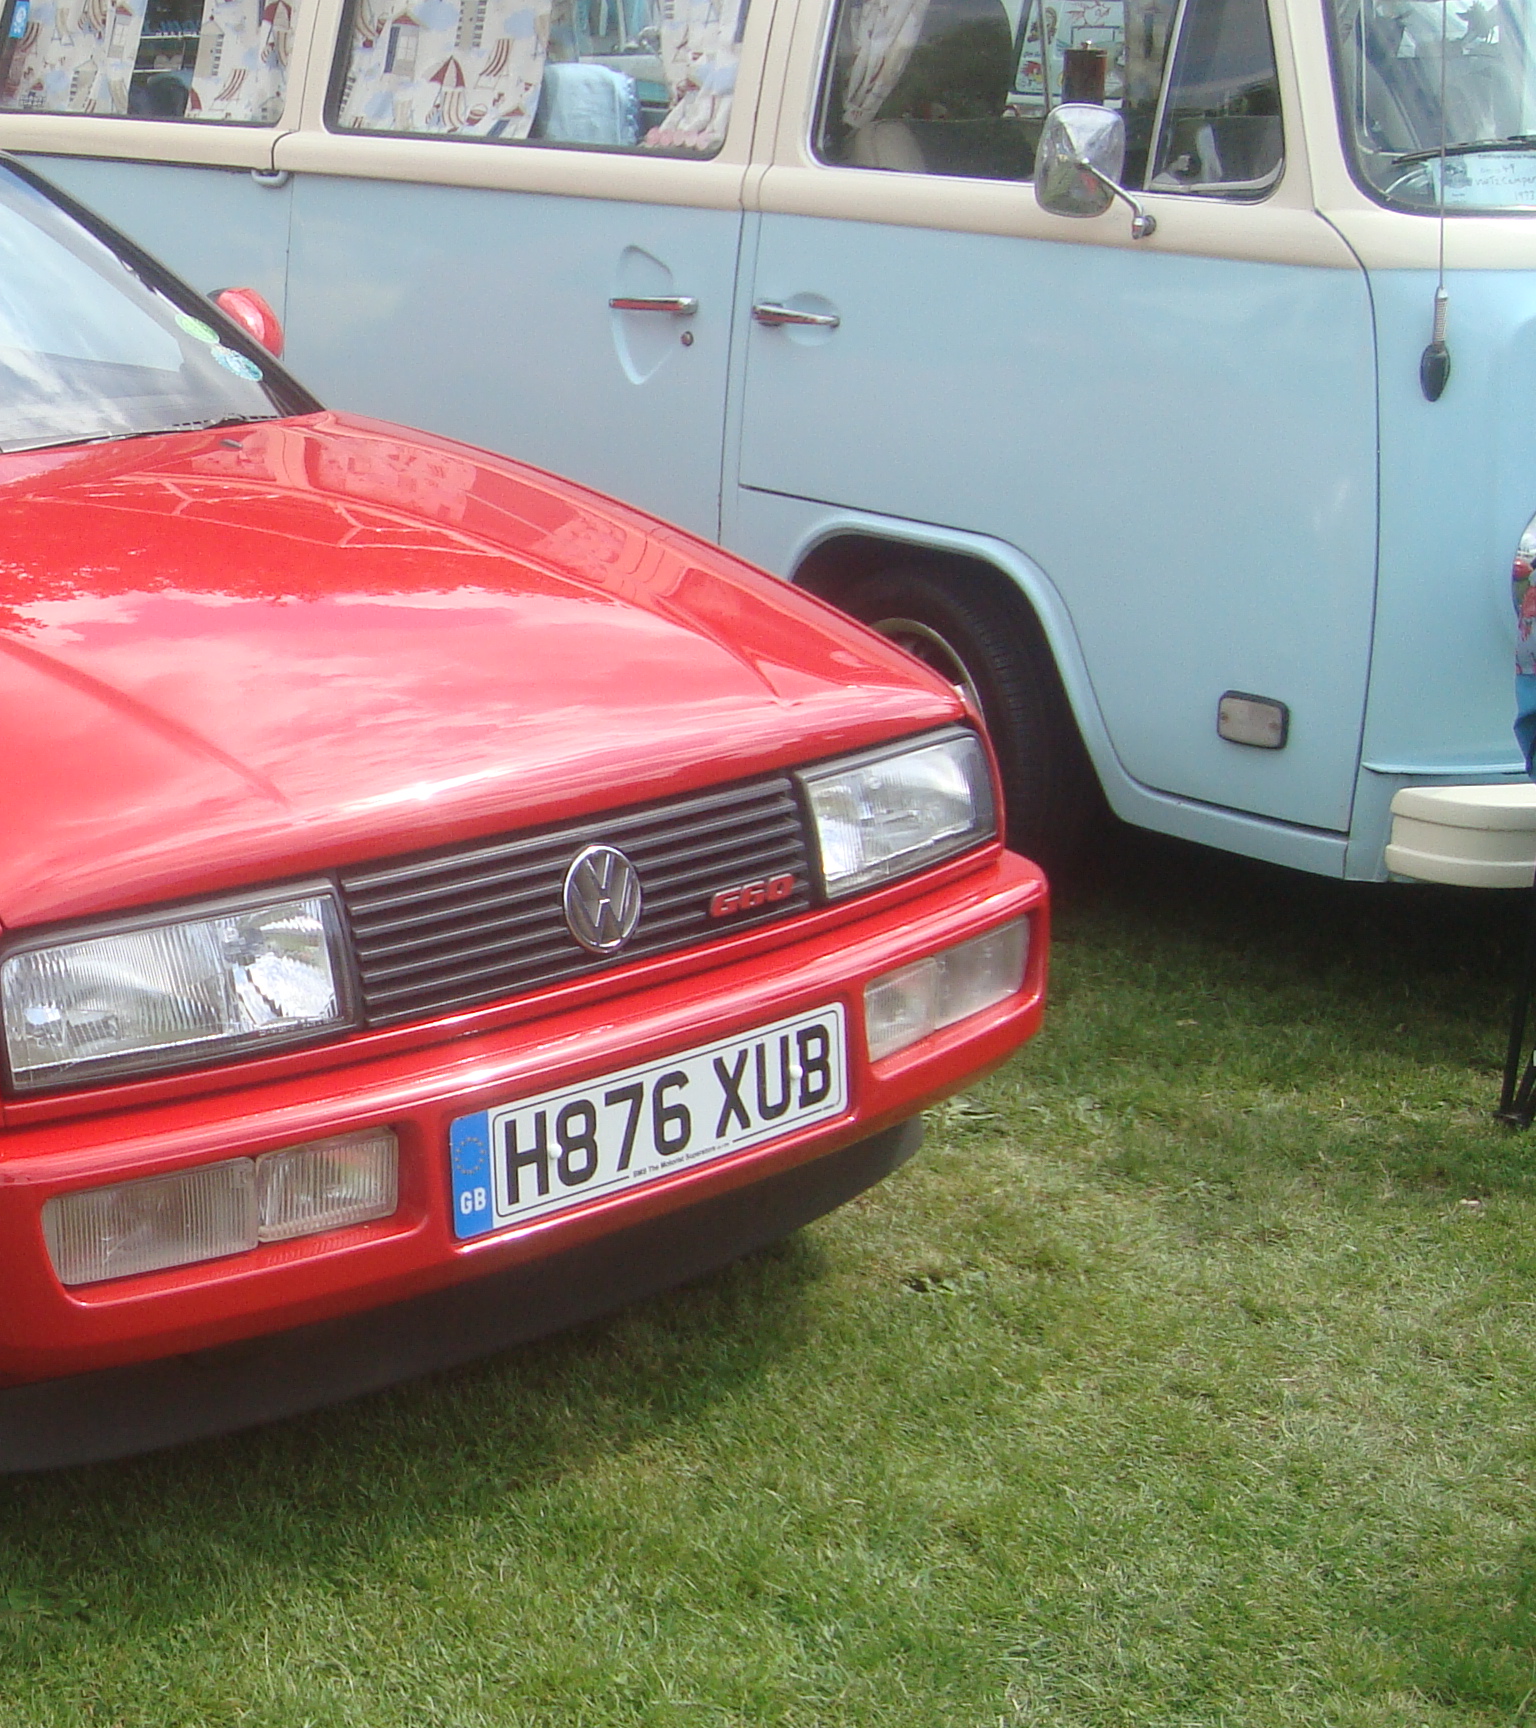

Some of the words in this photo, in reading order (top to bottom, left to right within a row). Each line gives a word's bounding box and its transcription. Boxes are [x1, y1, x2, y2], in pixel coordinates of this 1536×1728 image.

[710, 873, 795, 918] G60
[504, 1070, 691, 1206] H876
[712, 1024, 831, 1139] XUB
[460, 1187, 486, 1214] GB
